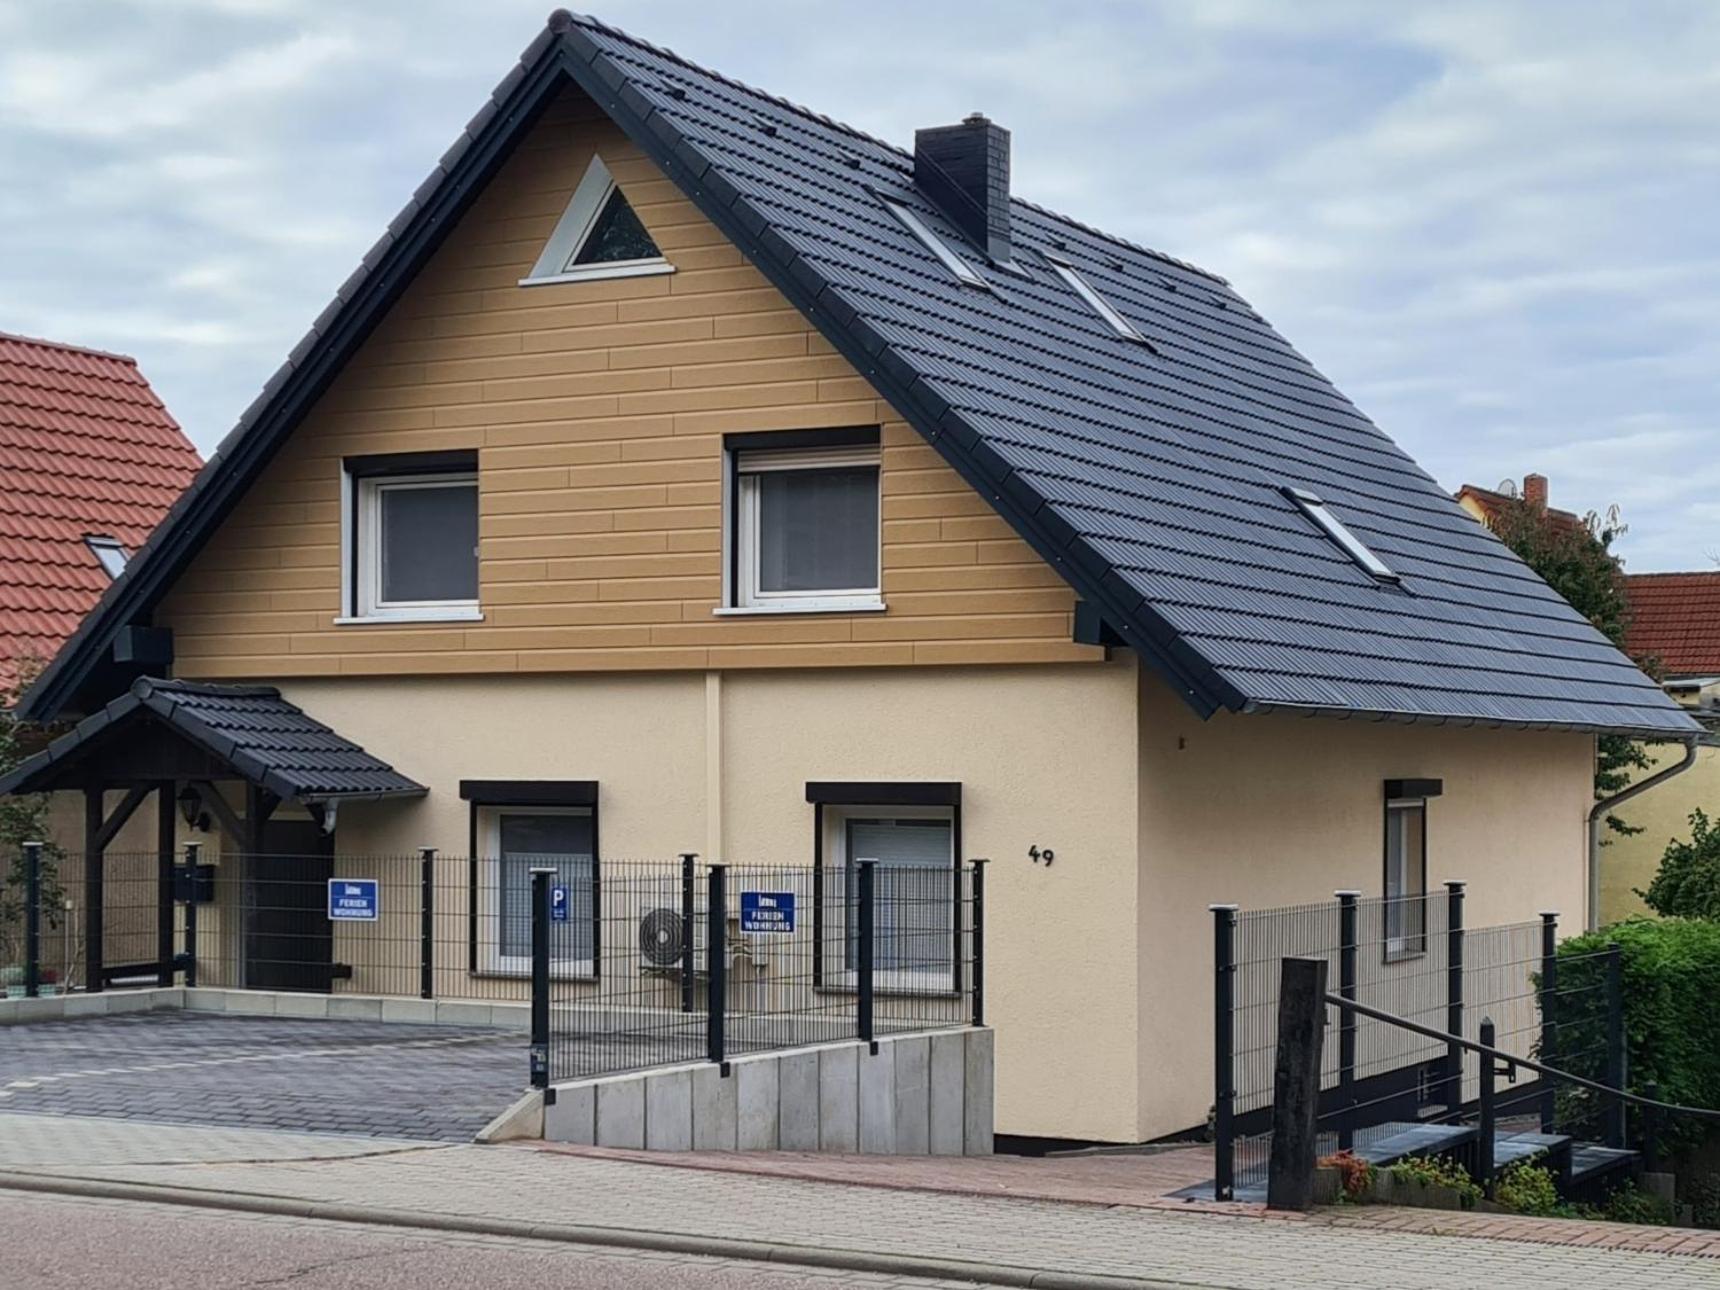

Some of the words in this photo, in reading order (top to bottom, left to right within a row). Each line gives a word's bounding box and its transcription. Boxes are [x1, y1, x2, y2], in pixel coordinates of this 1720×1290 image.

[1028, 844, 1054, 867] 49
[554, 889, 564, 907] P
[752, 911, 784, 920] FERIEN
